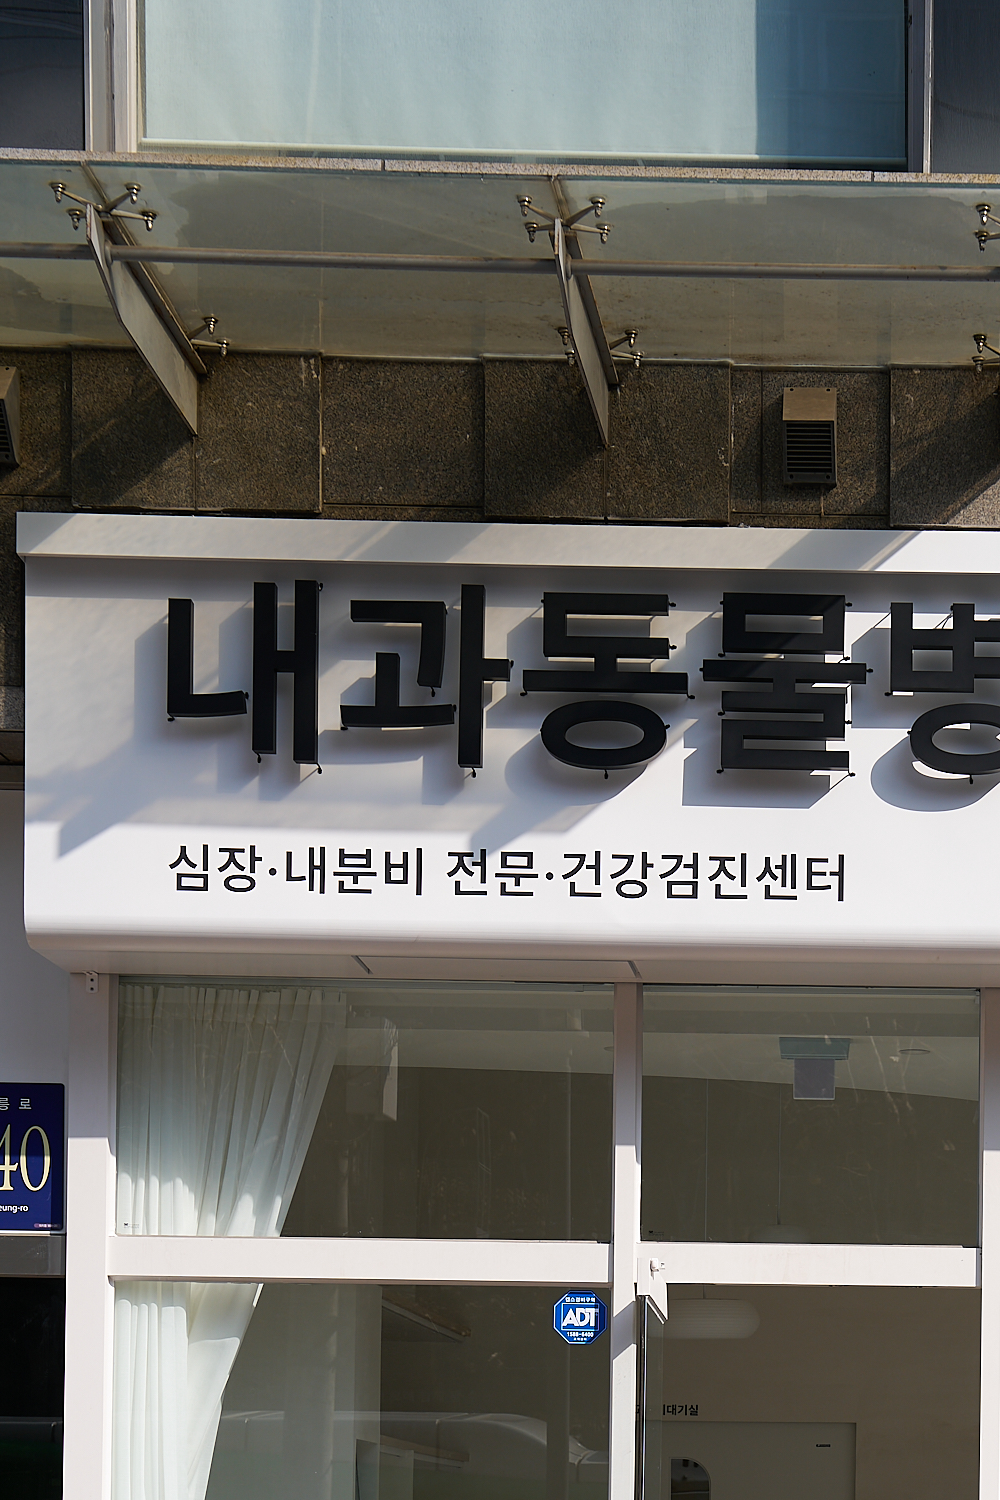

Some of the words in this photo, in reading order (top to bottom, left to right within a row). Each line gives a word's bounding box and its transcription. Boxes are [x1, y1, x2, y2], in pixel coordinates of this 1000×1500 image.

[168, 844, 423, 896] 심장·내분비
[446, 848, 846, 901] 전문·건강검진센터
[562, 1307, 599, 1327] ADT
